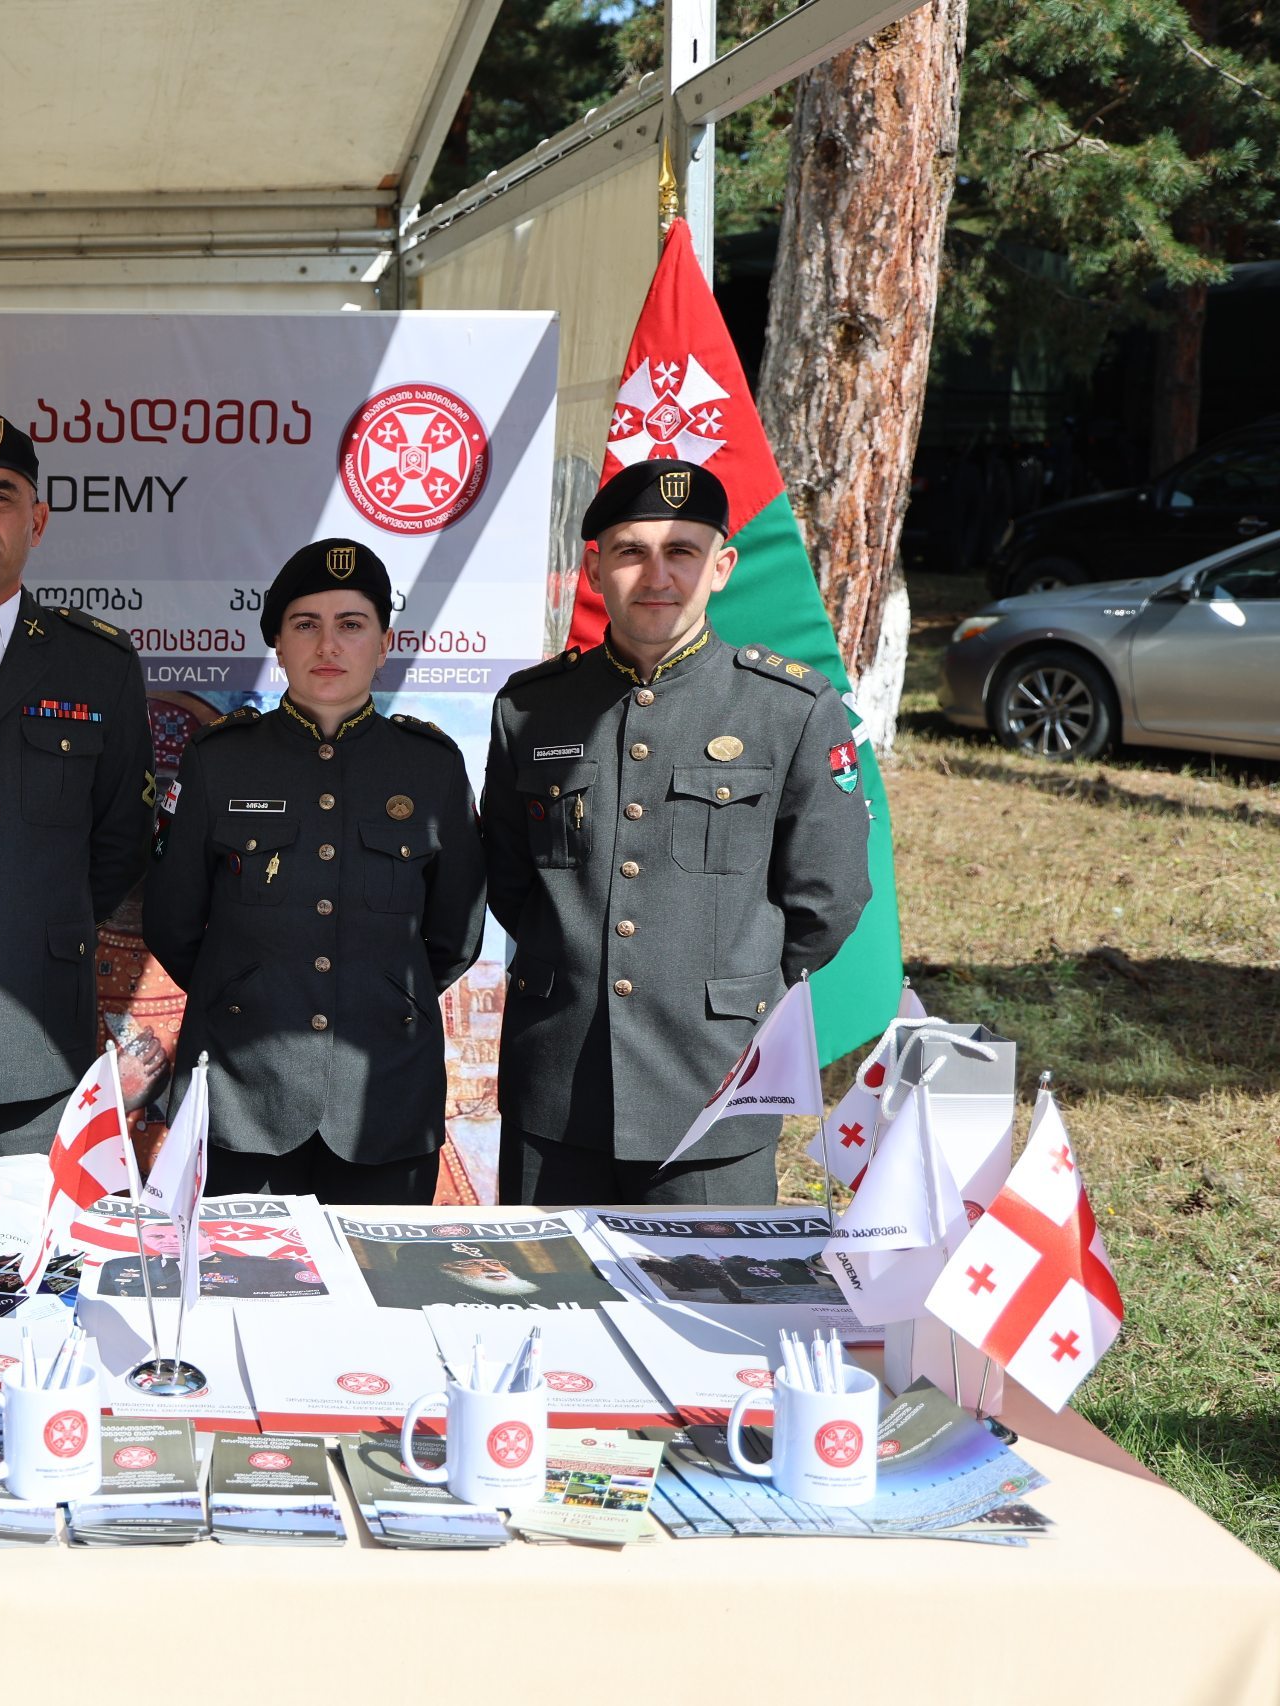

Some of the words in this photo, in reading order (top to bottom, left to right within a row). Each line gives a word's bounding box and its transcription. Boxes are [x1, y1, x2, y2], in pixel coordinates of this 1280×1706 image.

[29, 398, 312, 445] აკადემია
[46, 476, 188, 513] DEMY
[28, 587, 143, 611] ლეობა
[130, 628, 246, 652] ვისცემა
[147, 666, 230, 683] LOYALTY
[405, 668, 492, 685] RESPECT
[726, 1096, 758, 1107] დაცვის
[199, 1201, 286, 1216] NDA
[474, 1219, 570, 1237] NDA
[734, 1220, 832, 1235] NDA
